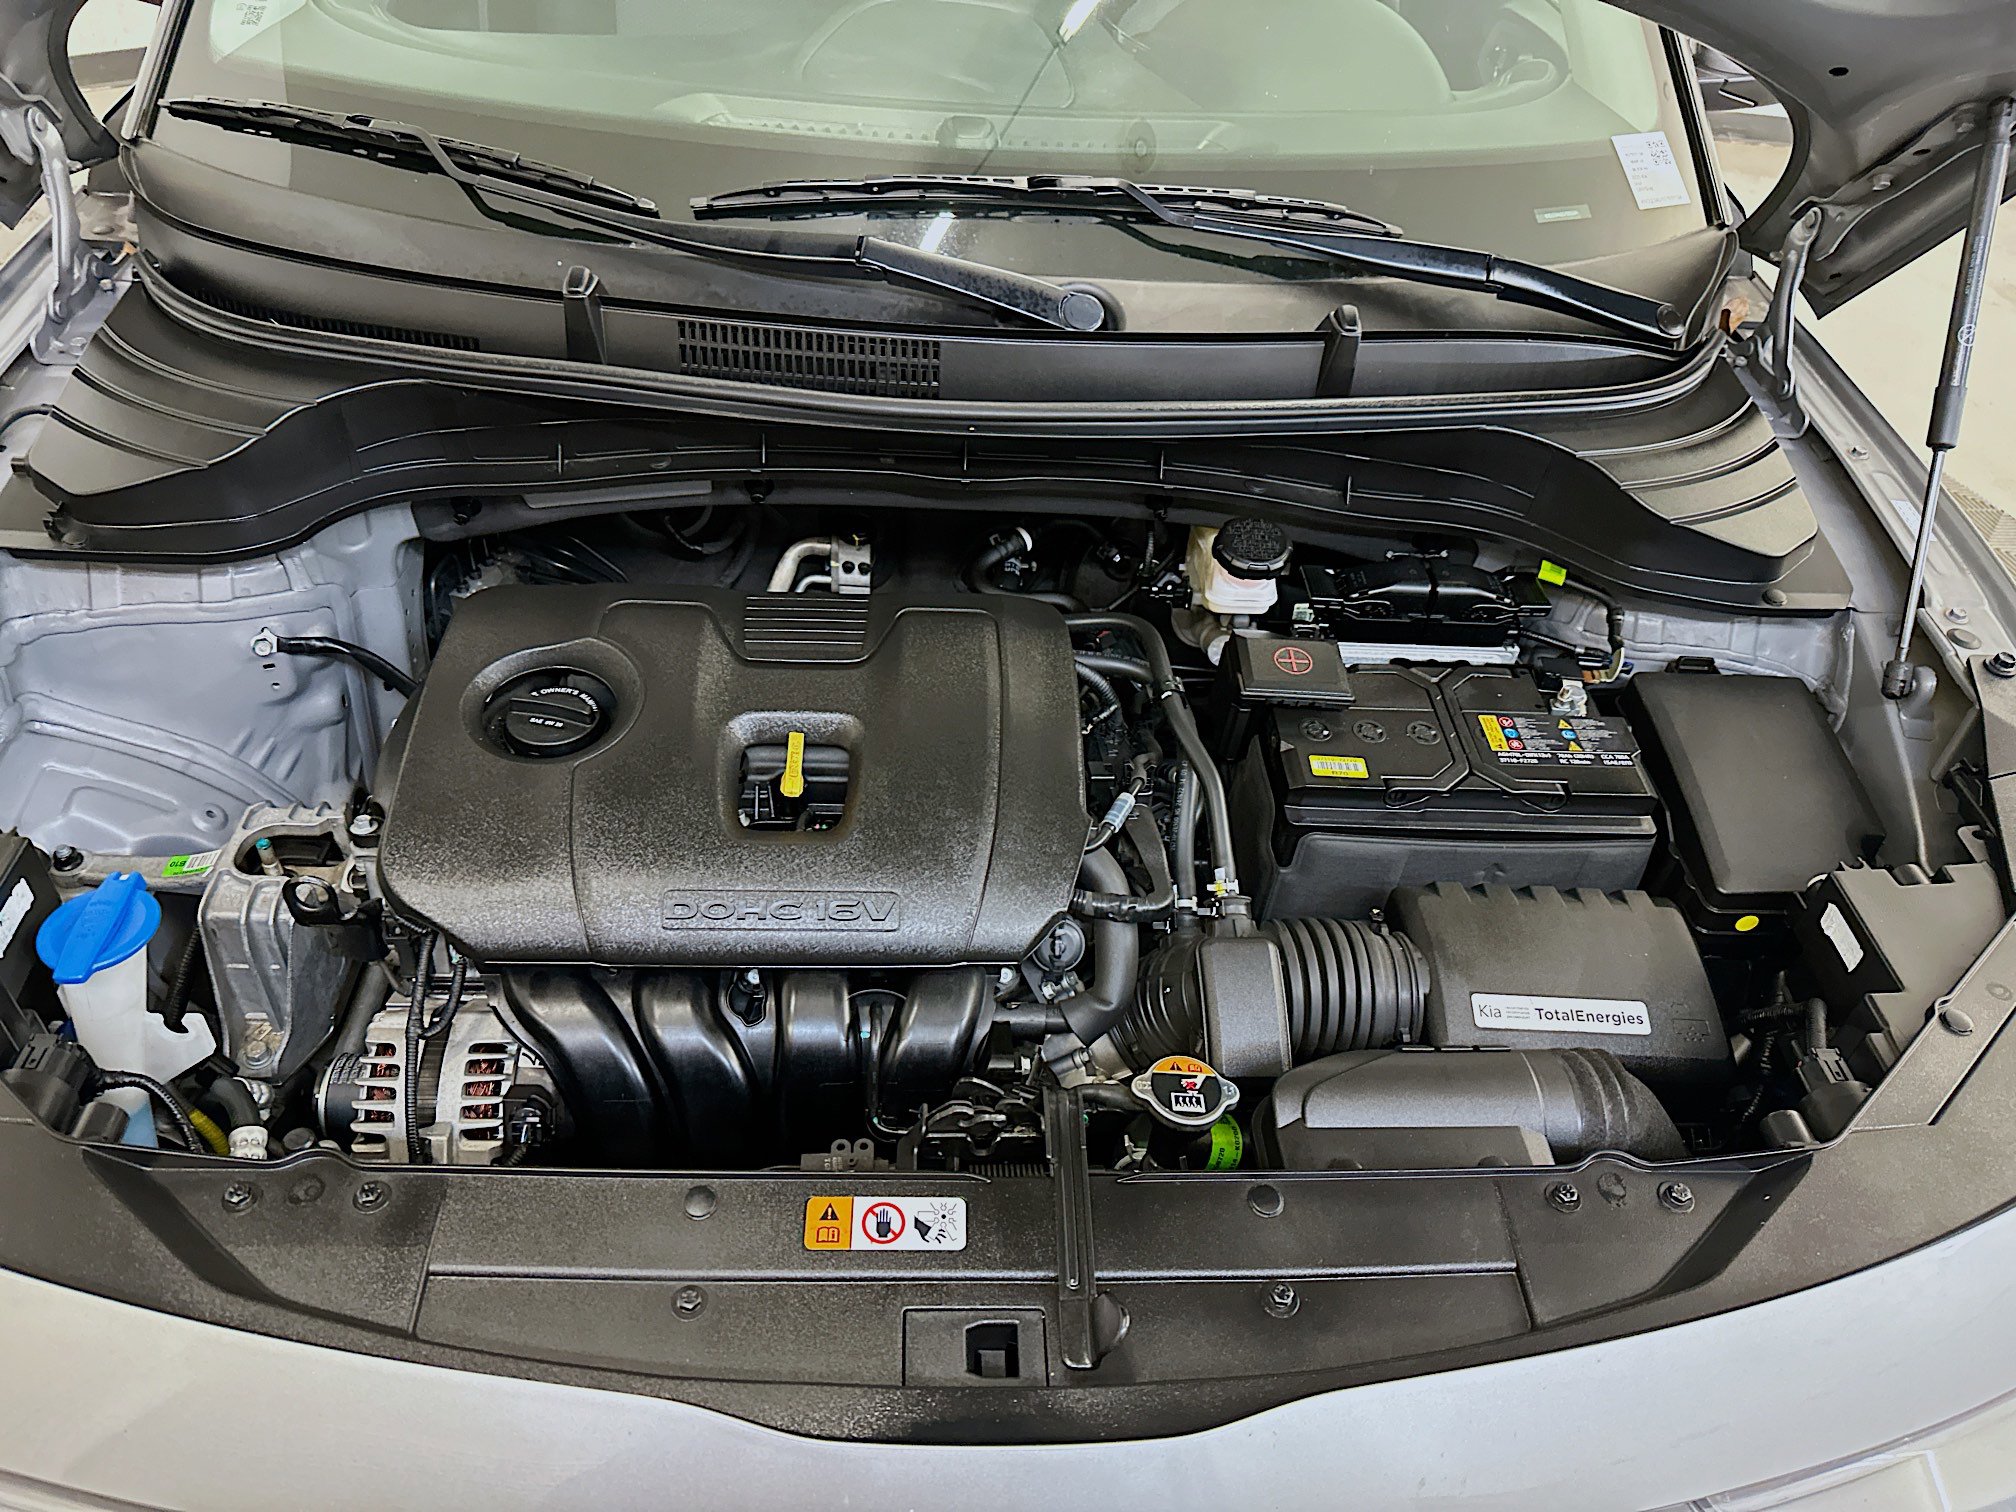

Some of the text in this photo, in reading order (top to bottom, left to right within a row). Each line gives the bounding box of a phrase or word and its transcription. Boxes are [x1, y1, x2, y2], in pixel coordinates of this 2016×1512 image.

[540, 687, 580, 696] OWNER'S
[664, 899, 896, 922] DOHC 16V
[1478, 1004, 1502, 1018] Kia
[1534, 1007, 1644, 1026] TotalEnergies
